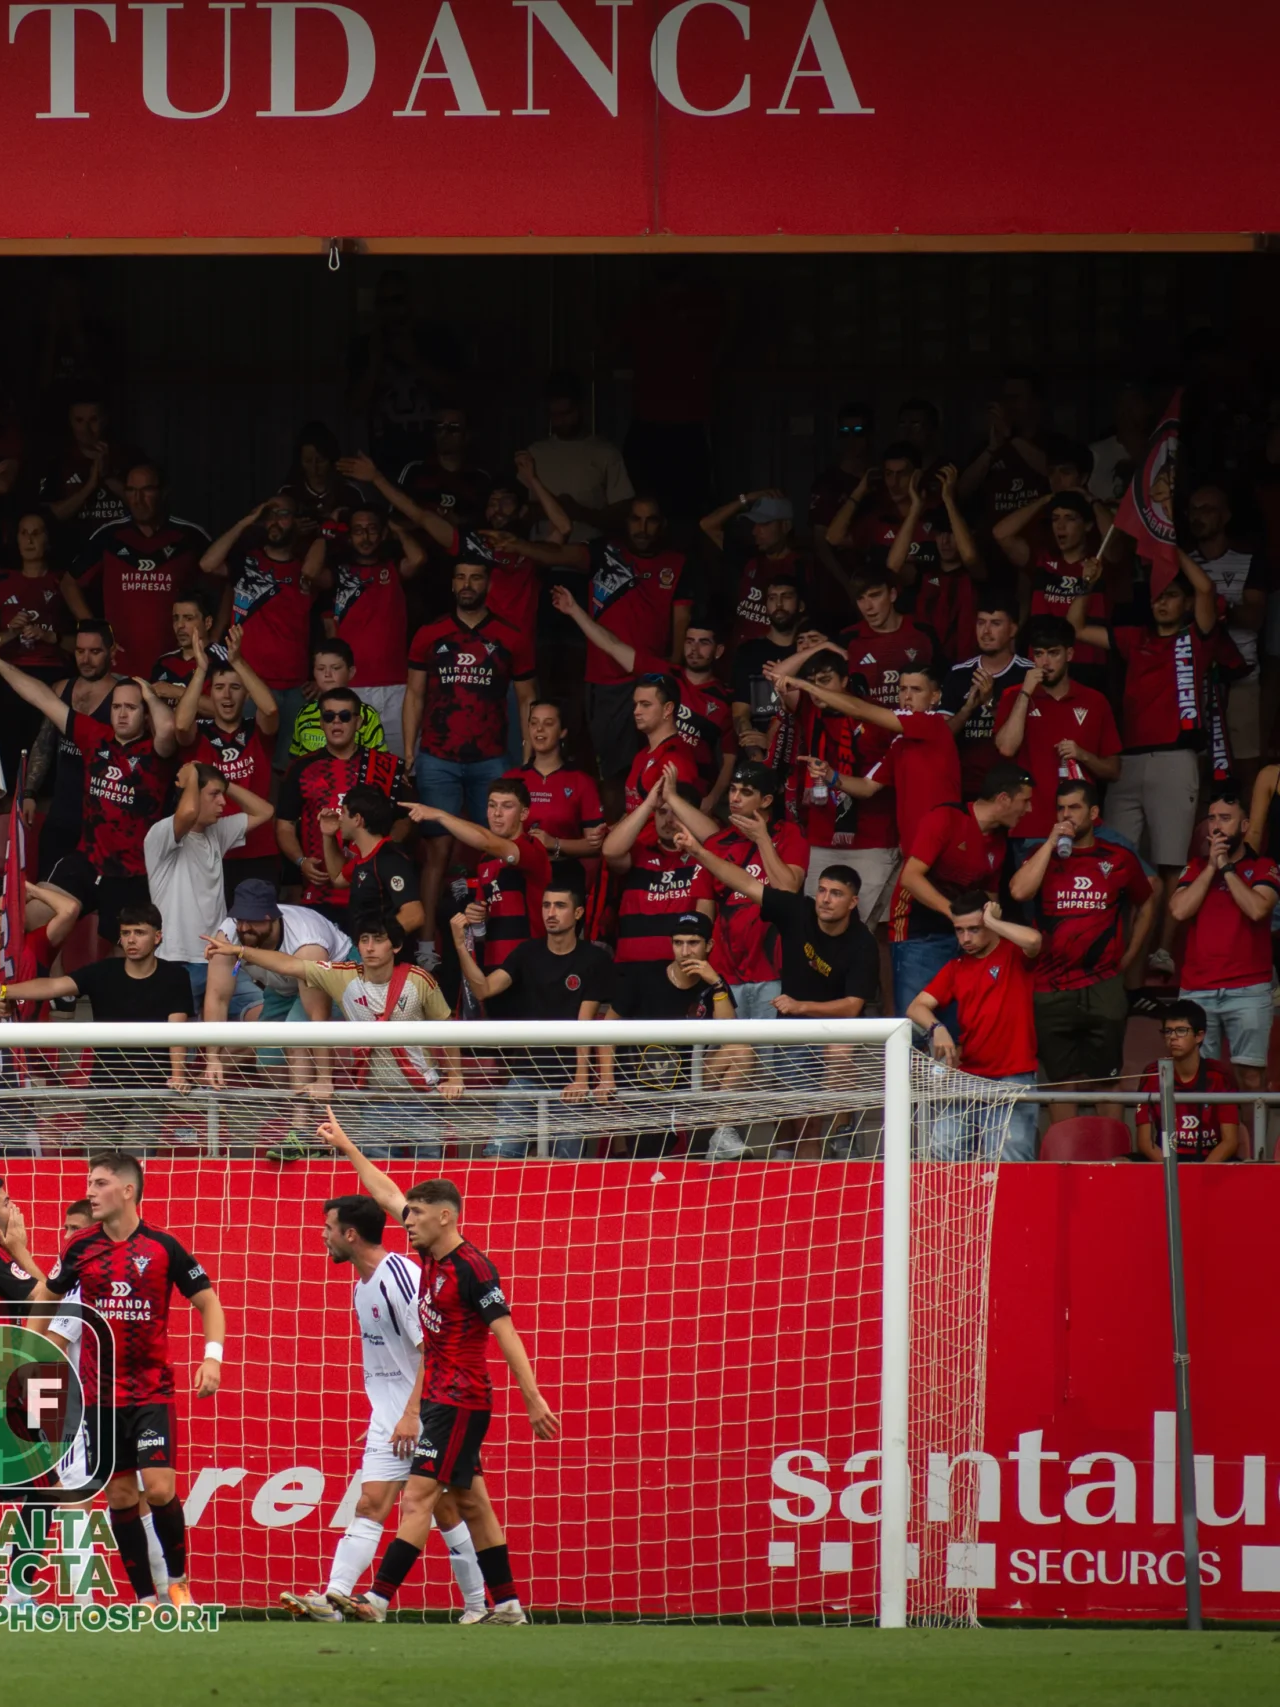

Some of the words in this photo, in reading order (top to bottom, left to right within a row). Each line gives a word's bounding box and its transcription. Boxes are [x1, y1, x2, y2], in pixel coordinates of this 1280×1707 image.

[9, 0, 876, 120] TUDANCA
[121, 573, 172, 582] MIRANDA
[121, 582, 172, 592] EMPRESAS
[439, 666, 493, 677] MIRANDA
[441, 675, 492, 686] EMPRESAS
[90, 776, 135, 796] MIRANDA
[89, 786, 134, 805] EMPRESAS
[1057, 890, 1108, 900] MIRANDA
[1057, 900, 1107, 910] EMPRESAS
[95, 1299, 151, 1309] MIRANDA
[137, 1436, 165, 1448] Alucoil
[767, 1411, 1280, 1526] santalu
[1008, 1546, 1222, 1588] SEGUROS
